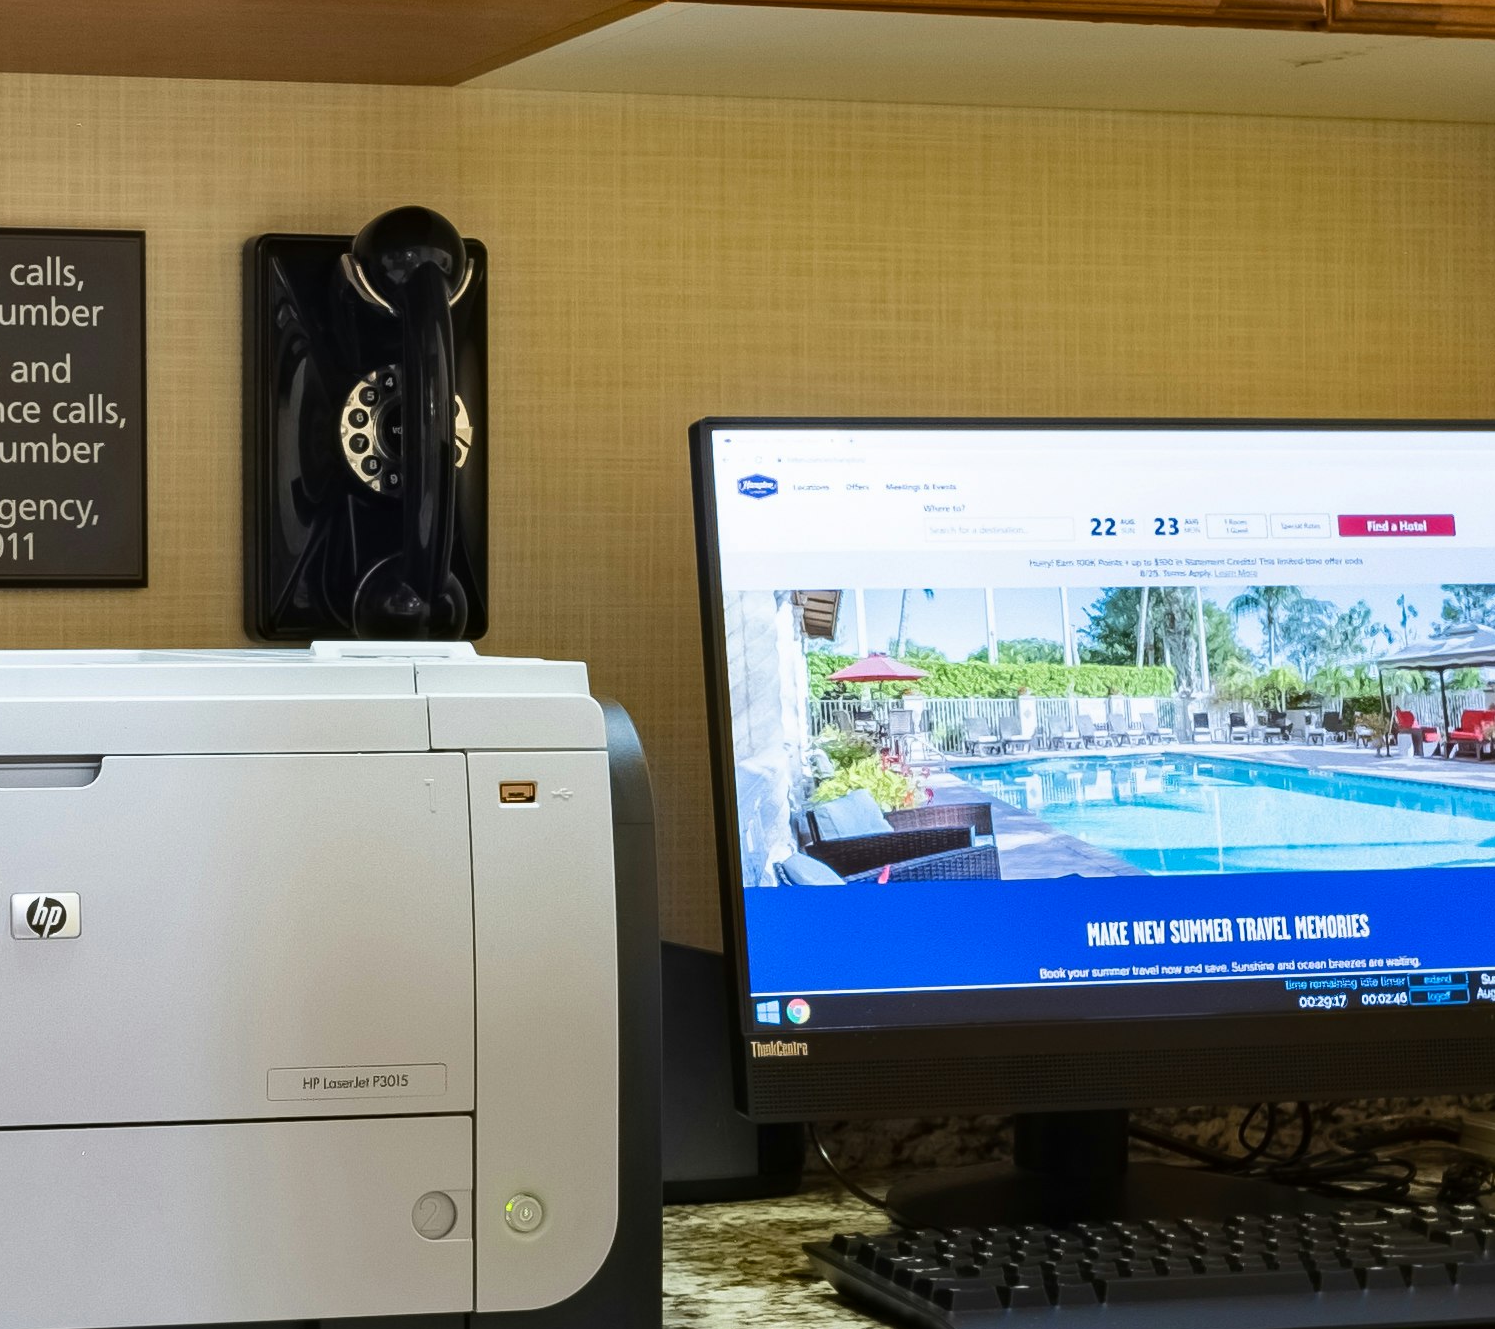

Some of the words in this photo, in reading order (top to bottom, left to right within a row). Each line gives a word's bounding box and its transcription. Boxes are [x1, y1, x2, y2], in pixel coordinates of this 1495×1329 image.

[10, 255, 85, 291] calls,
[10, 353, 72, 383] and
[385, 377, 394, 388] 4
[366, 391, 375, 401] 5
[52, 393, 127, 429] calls,
[356, 412, 364, 423] 6
[356, 437, 365, 448] 7
[369, 459, 378, 470] 8
[389, 473, 398, 485] 9
[1089, 517, 1118, 537] 22
[1153, 517, 1180, 536] 23
[1367, 520, 1389, 533] Find
[1399, 520, 1427, 533] Hotel
[31, 896, 64, 939] hp
[1087, 921, 1130, 947] MAKE
[1133, 920, 1166, 945] NEW
[1170, 918, 1233, 944] SUMMER
[1236, 916, 1291, 942] TRAVEL
[1295, 913, 1371, 939] MEMORIES
[302, 1077, 320, 1089] HP
[323, 1076, 370, 1089] LaserJet
[372, 1074, 409, 1088] P3015
